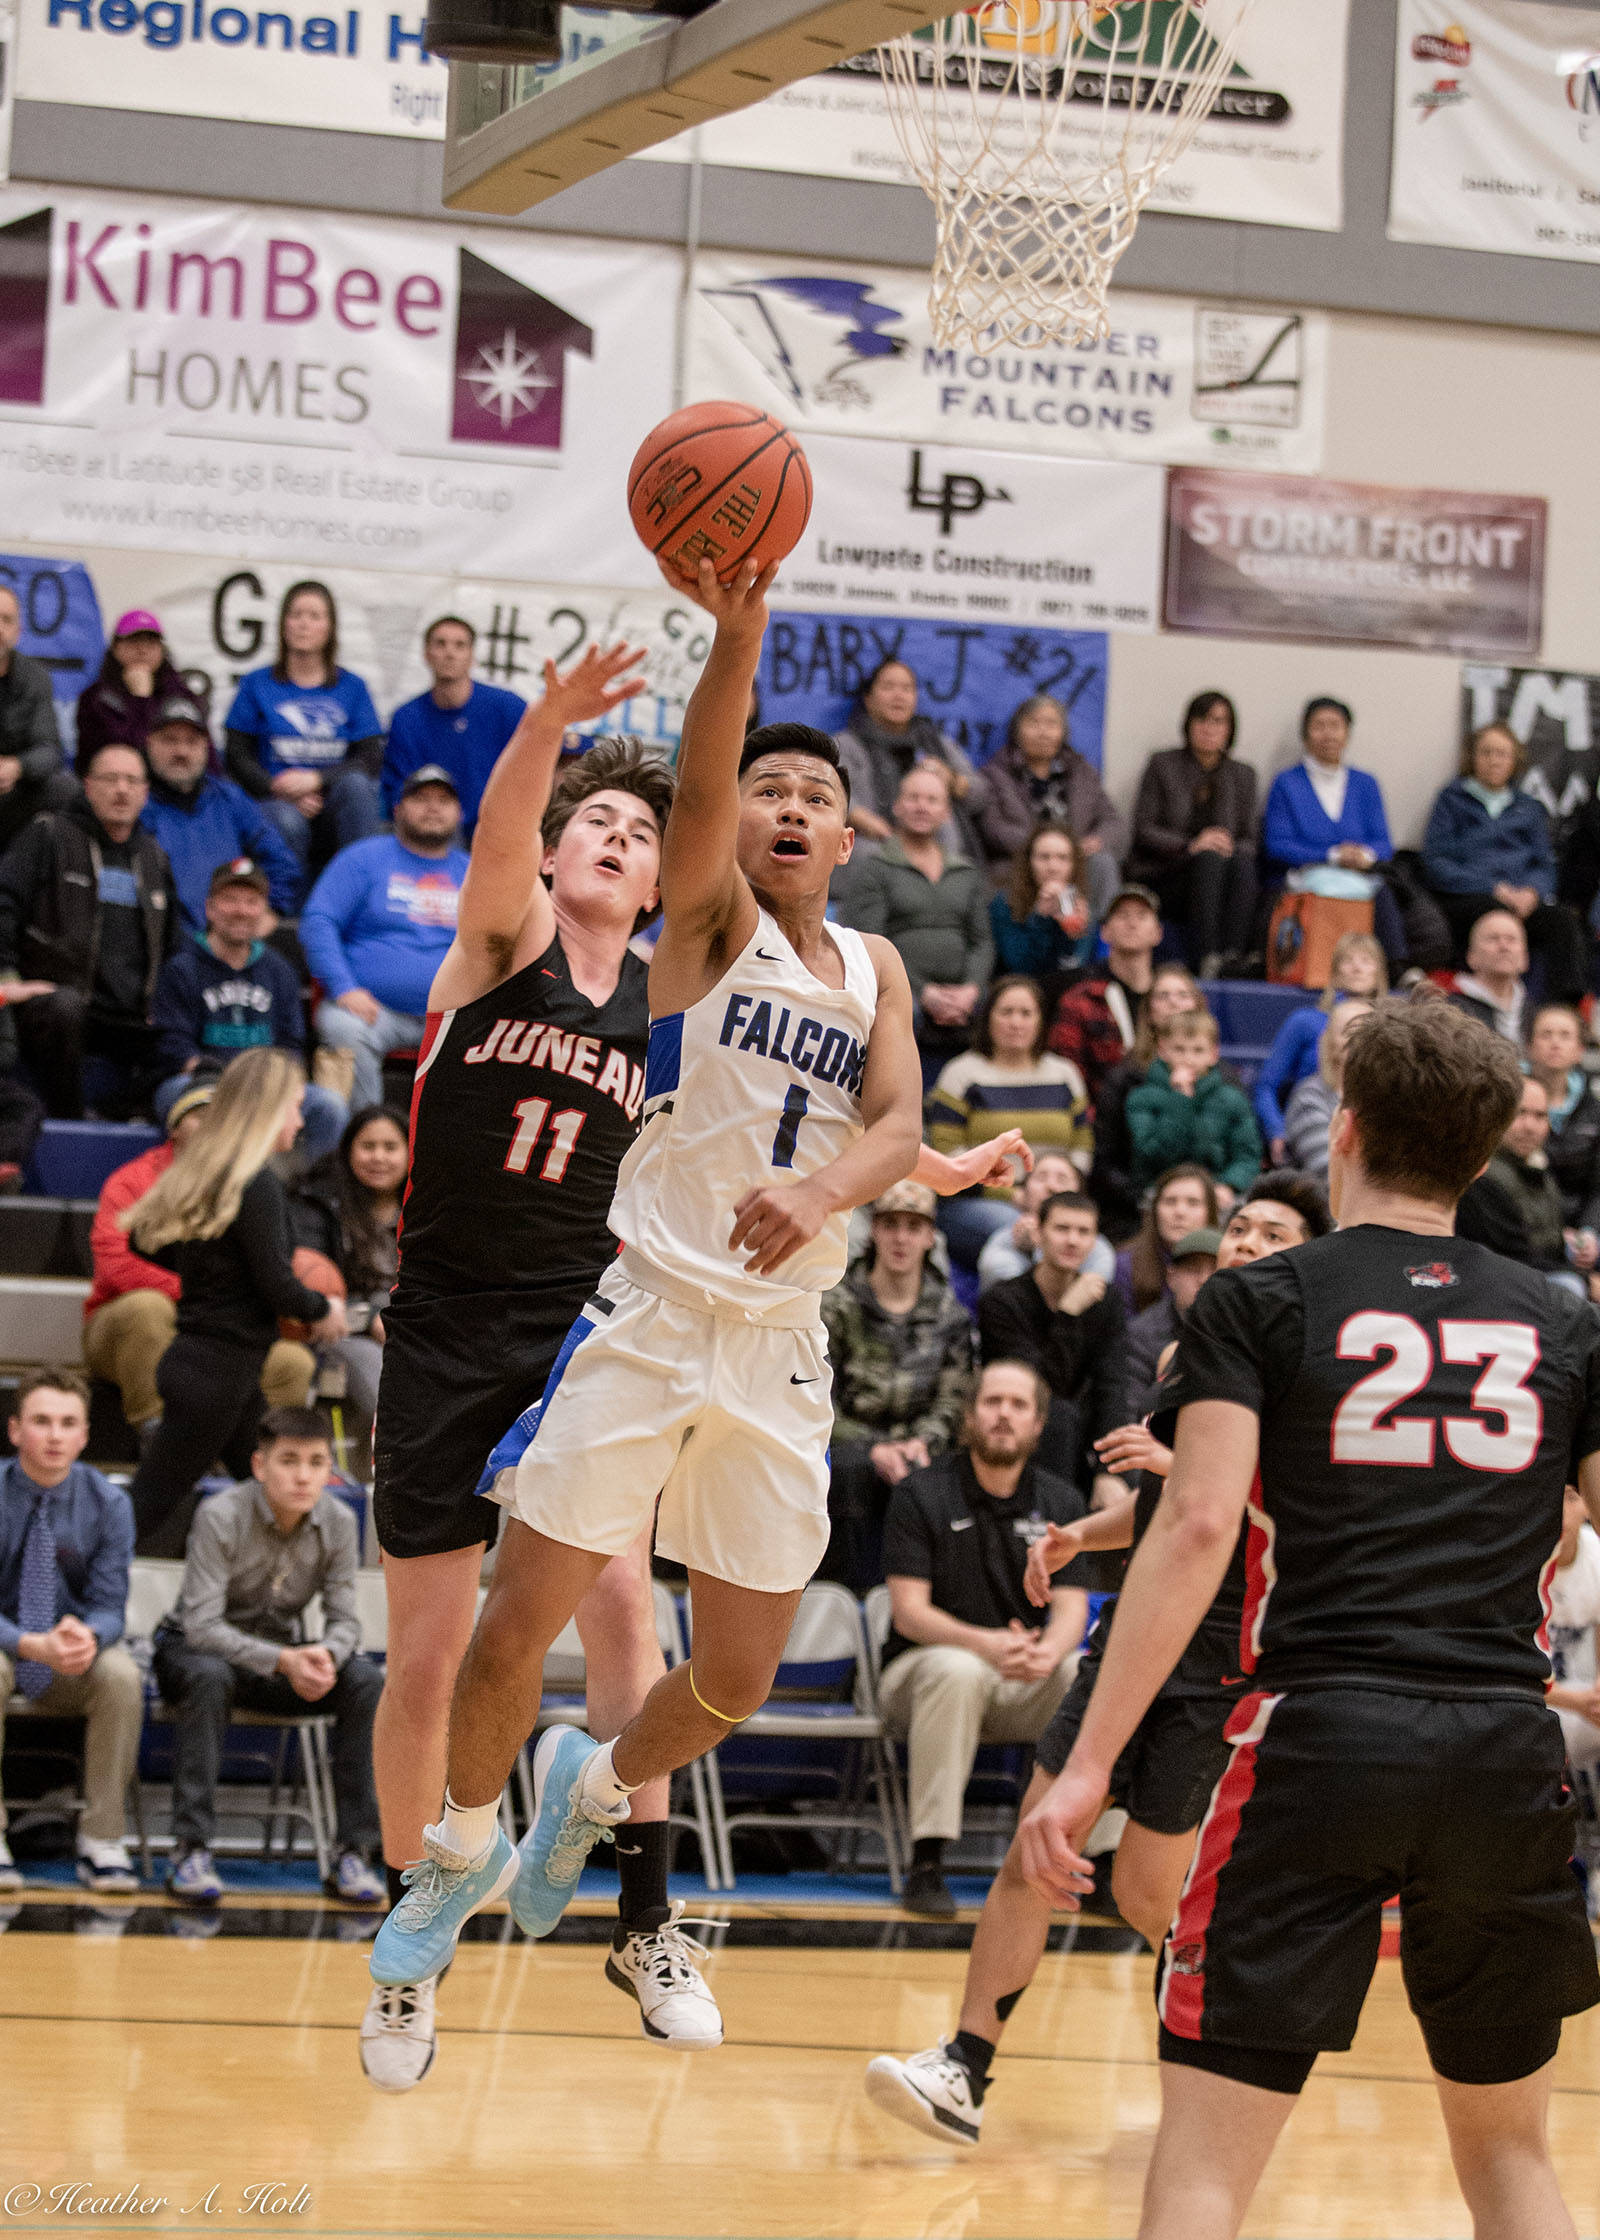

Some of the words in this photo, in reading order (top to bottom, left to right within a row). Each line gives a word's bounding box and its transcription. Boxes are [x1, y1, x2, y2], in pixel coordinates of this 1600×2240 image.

[46, 0, 358, 58] Regional
[62, 221, 444, 340] KimBee
[127, 348, 371, 425] HOMES
[923, 346, 1174, 398] MOUNTAIN
[940, 386, 1156, 435] FALCONS
[271, 465, 335, 498] Real
[340, 471, 424, 507] Estate
[711, 483, 763, 540] THE
[817, 539, 923, 573] Lowpete
[932, 548, 1096, 585] Construction
[1189, 502, 1360, 555] STORM
[1369, 516, 1525, 570] FRONT
[771, 621, 906, 698] BABY
[924, 626, 985, 703] J
[464, 1019, 646, 1122] JUNEAU
[719, 993, 867, 1099] FALCON
[503, 1096, 588, 1184] 11
[771, 1084, 811, 1168] 1
[1330, 1309, 1545, 1474] 23
